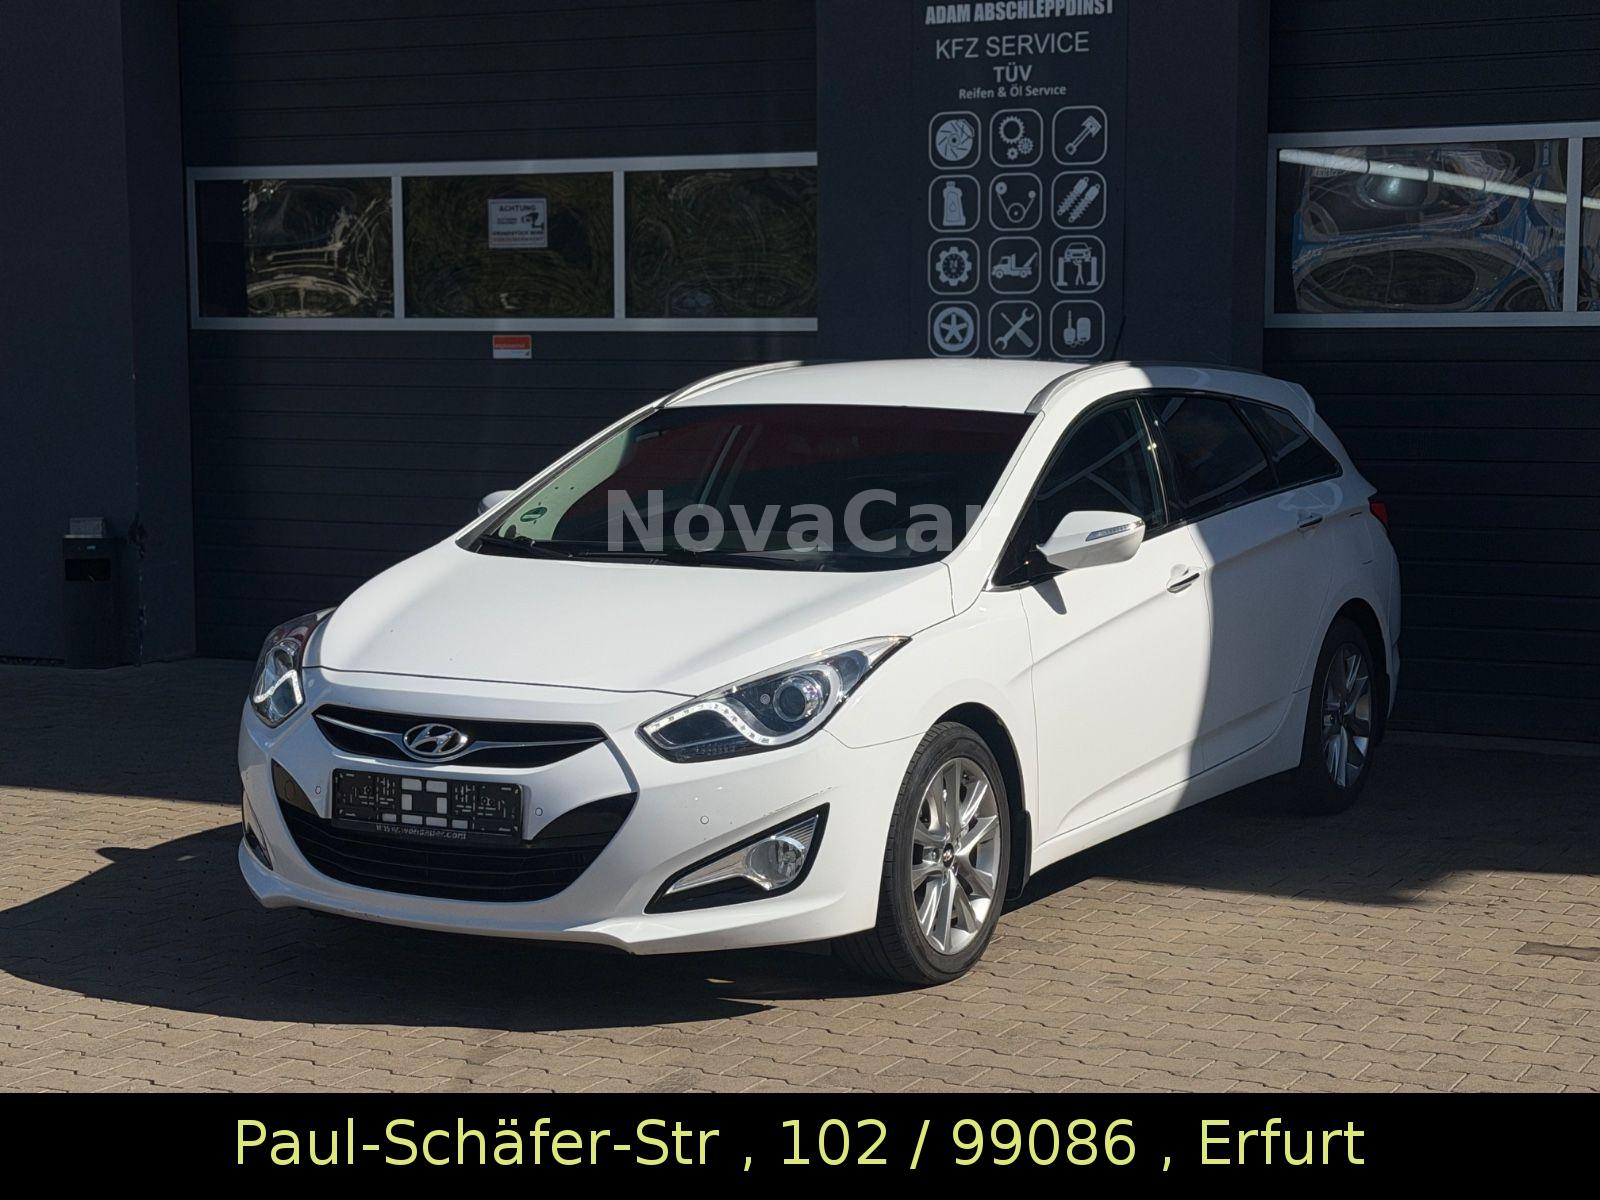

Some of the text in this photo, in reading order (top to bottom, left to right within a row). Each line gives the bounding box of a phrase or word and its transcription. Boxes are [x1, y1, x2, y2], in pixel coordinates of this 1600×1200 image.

[925, 0, 1113, 25] ADAM ABSCHLEPPDINST
[936, 31, 1090, 60] KFZ SERVICE
[993, 62, 1032, 83] TÜV
[959, 83, 1067, 99] Reifen & Öl Service
[499, 204, 536, 212] ACHTUNG
